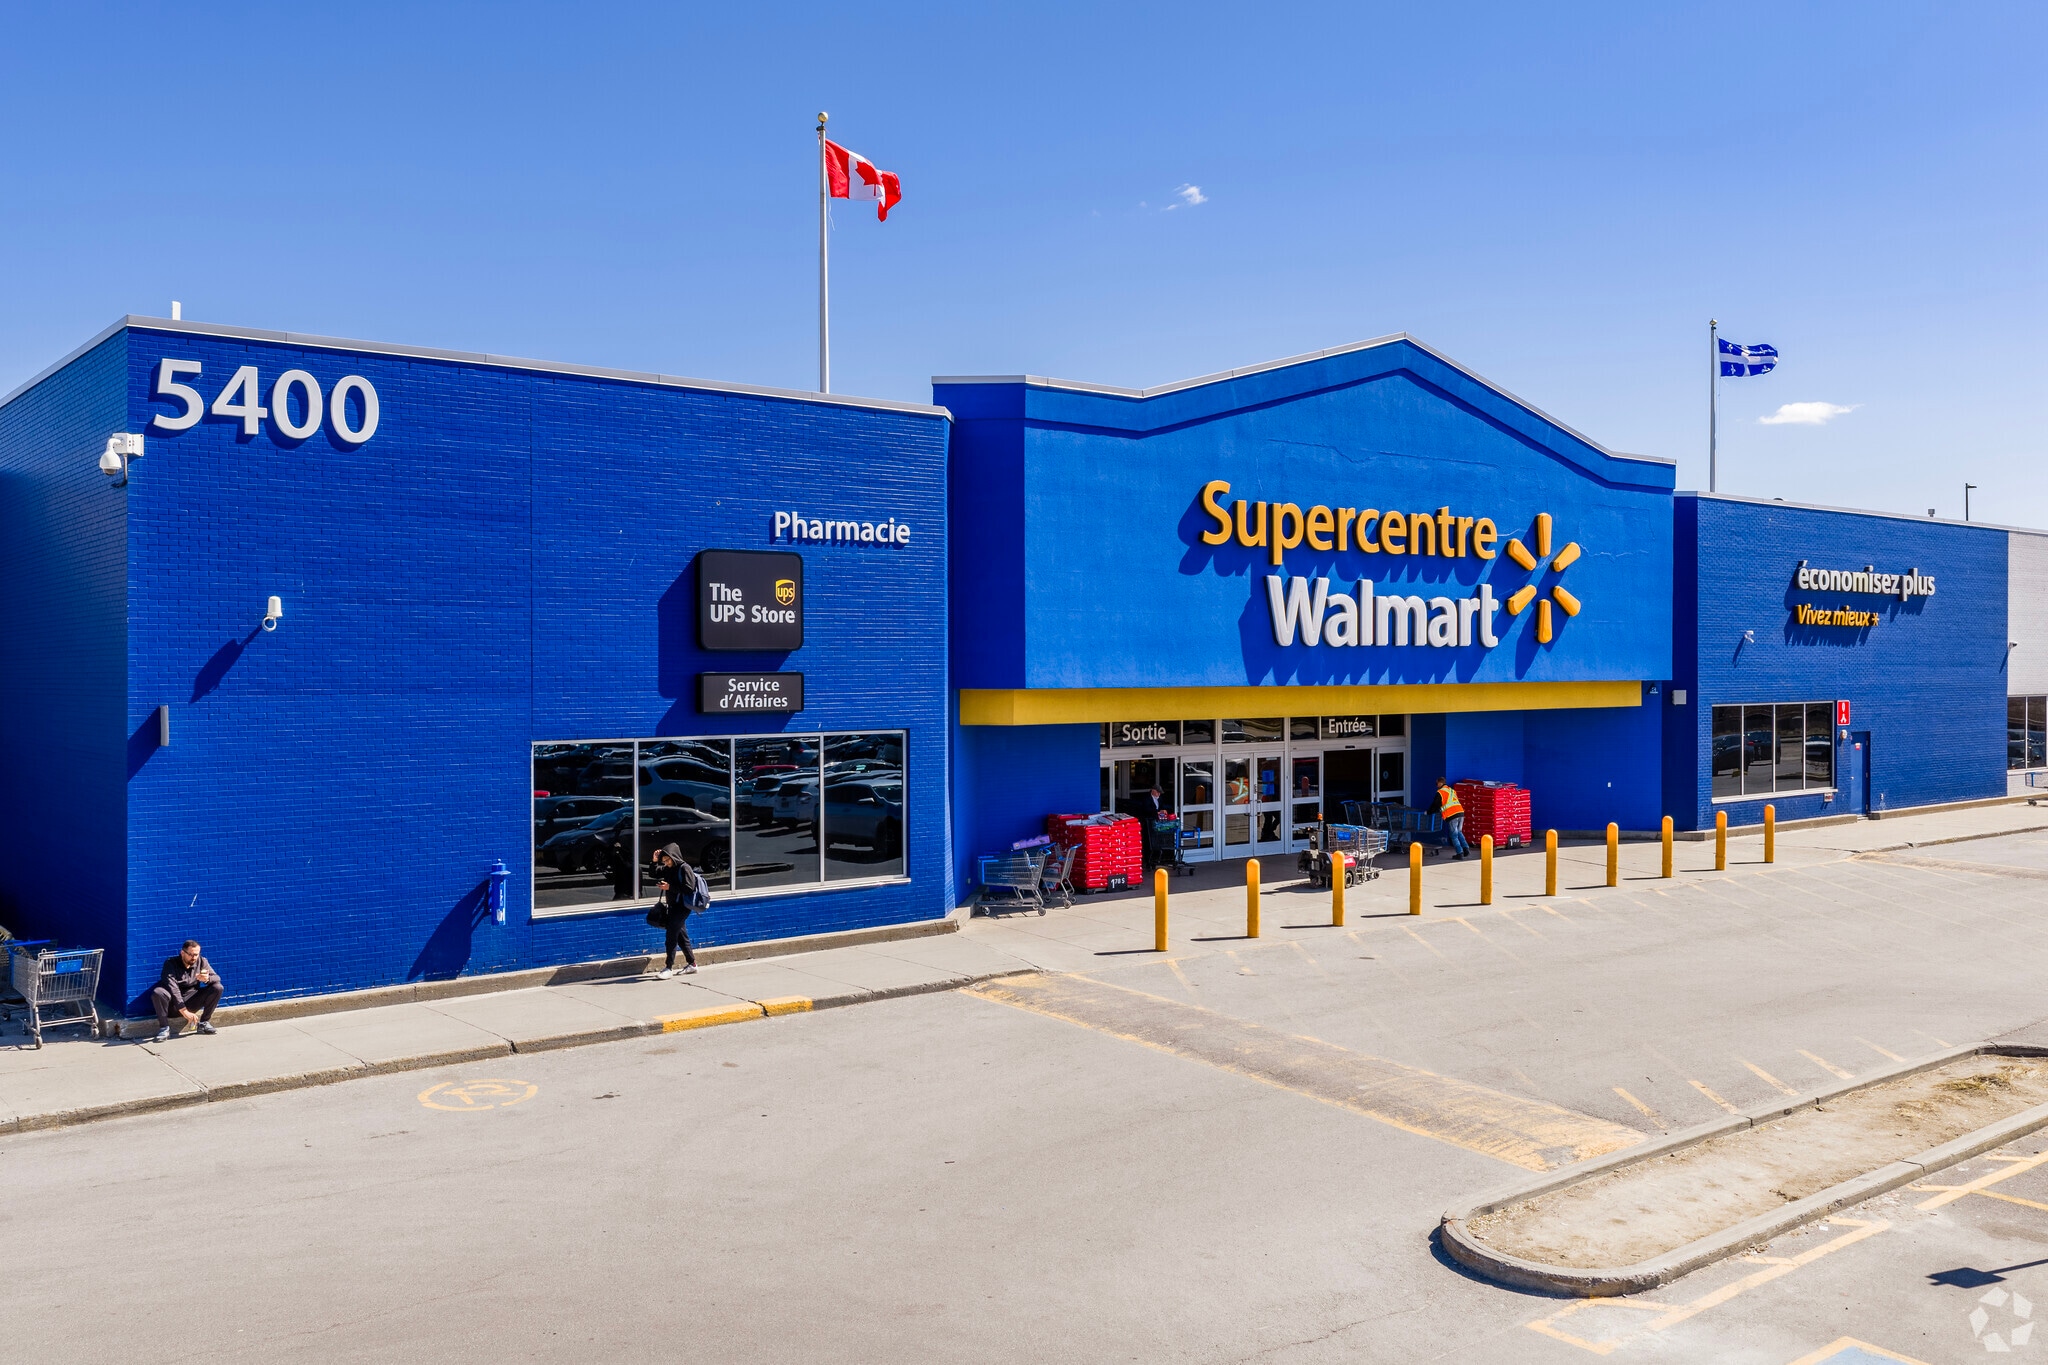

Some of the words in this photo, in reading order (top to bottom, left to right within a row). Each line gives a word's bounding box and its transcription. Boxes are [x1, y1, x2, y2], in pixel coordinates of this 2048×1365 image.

[153, 358, 380, 444] 5400
[773, 511, 911, 544] Pharmacie
[1202, 480, 1498, 565] Supercentre
[709, 582, 742, 602] The
[1798, 560, 1900, 593] économisez
[1903, 567, 1936, 602] plus
[710, 605, 746, 623] UPS
[751, 604, 795, 624] Store
[1267, 575, 1499, 648] Walmart
[1796, 604, 1831, 626] Vivez
[1833, 606, 1871, 626] mieux
[728, 678, 780, 693] Service
[1122, 722, 1167, 742] Sortie
[1328, 717, 1367, 735] Entrée
